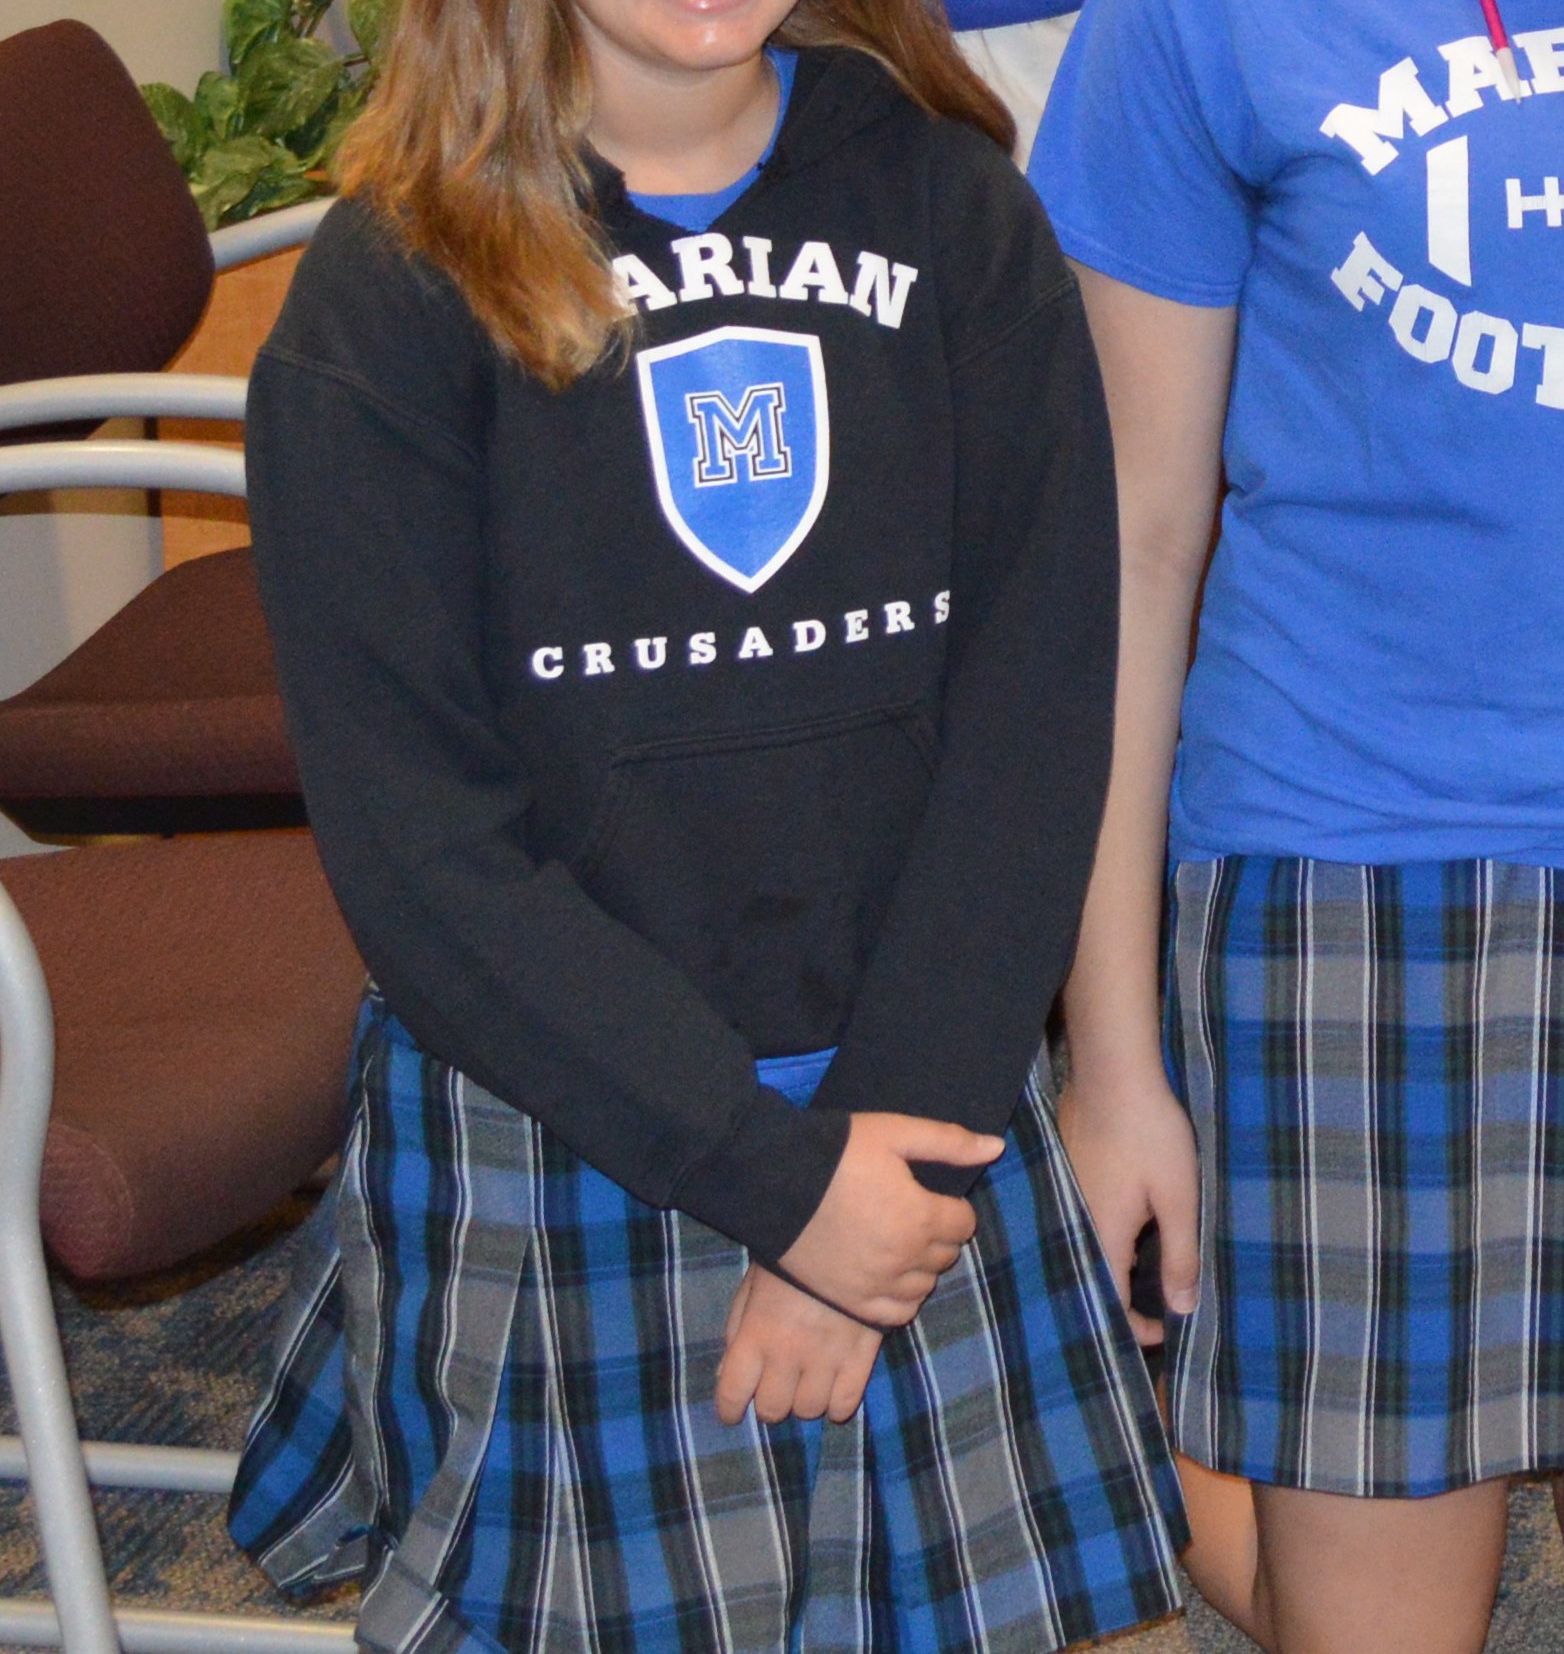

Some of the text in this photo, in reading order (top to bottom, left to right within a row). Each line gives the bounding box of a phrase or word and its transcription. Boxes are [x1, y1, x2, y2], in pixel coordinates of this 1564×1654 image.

[611, 232, 919, 330] ARIAN
[685, 382, 792, 489] M
[532, 590, 951, 680] CRUSADERS
